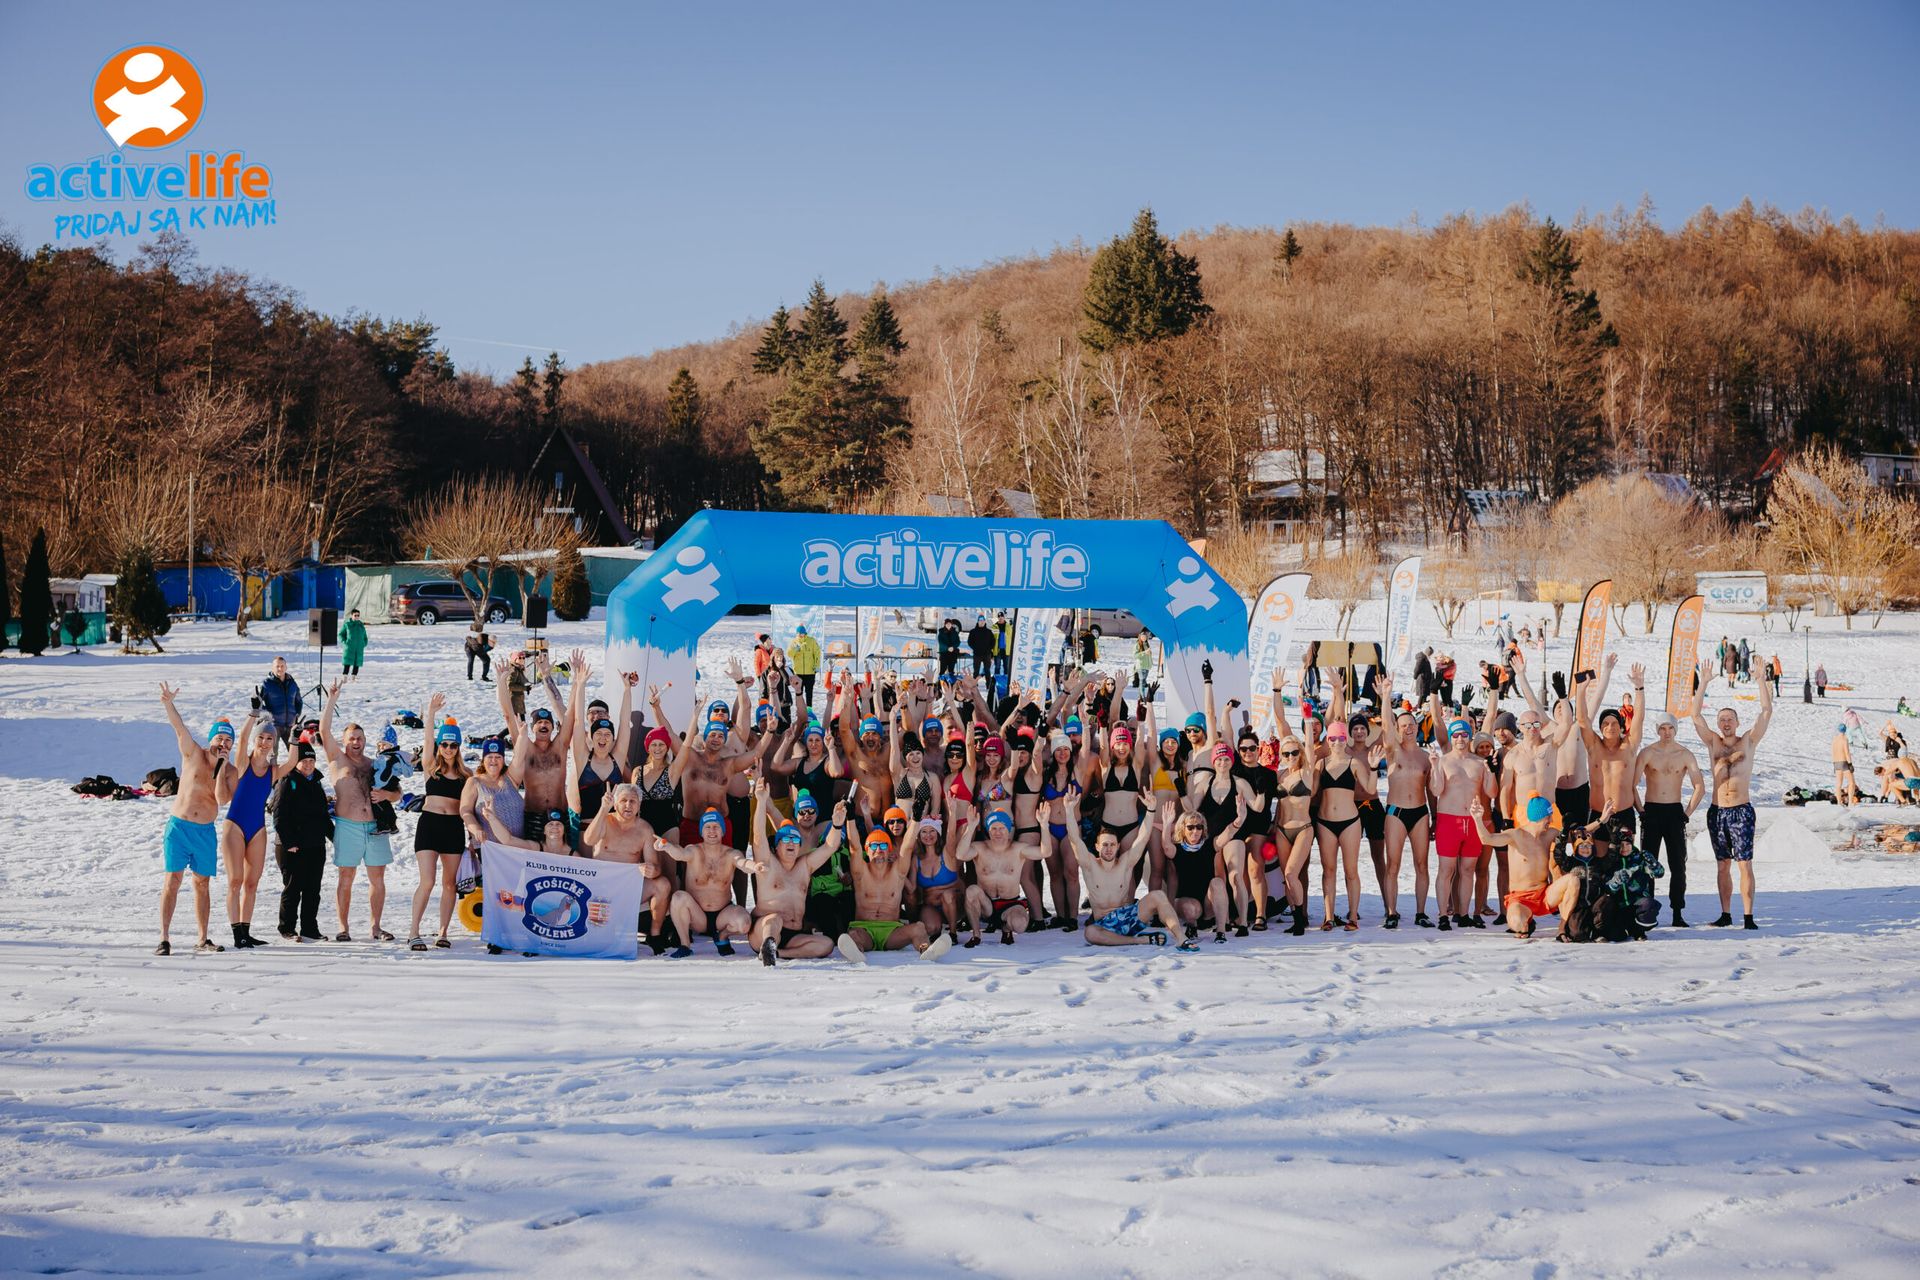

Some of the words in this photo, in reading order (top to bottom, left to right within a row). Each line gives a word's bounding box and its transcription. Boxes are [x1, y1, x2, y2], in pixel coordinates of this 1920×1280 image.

[802, 528, 1089, 590] activelife
[1710, 586, 1754, 599] aero
[1018, 616, 1029, 654] PRIDAJ
[526, 861, 548, 871] KLUB
[549, 865, 597, 877] OTUŽILCOV
[534, 878, 585, 898] KOŠICKÉ
[532, 922, 575, 938] TULENE
